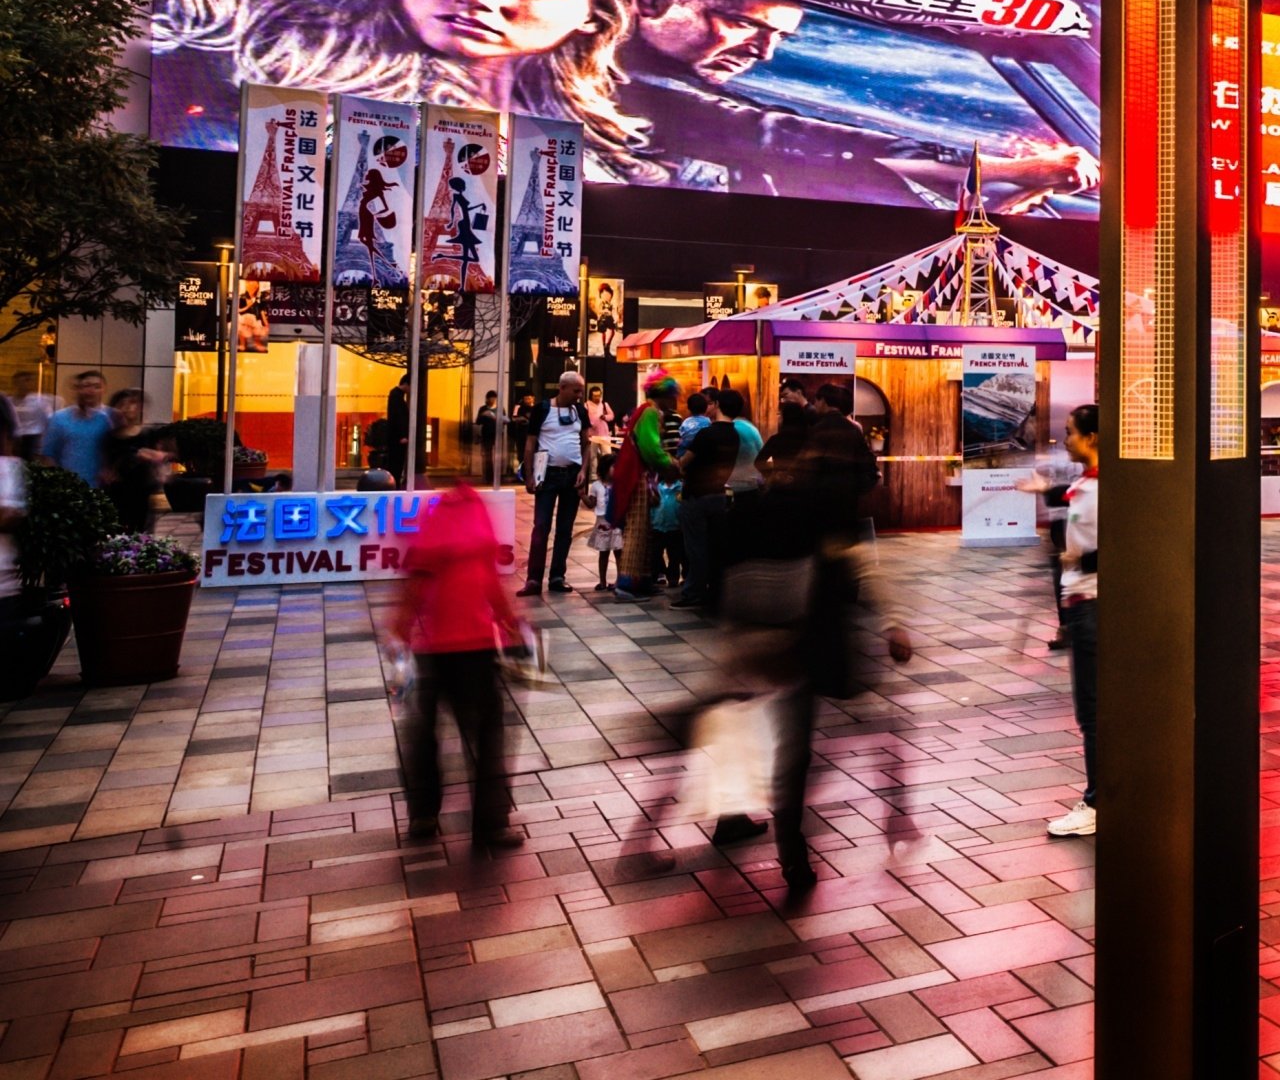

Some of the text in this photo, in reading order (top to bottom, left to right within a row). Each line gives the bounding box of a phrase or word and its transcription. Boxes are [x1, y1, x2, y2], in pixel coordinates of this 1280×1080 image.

[295, 110, 319, 239] 法国文化节
[278, 175, 294, 238] FESTIVAL
[556, 140, 576, 258] 法国文化节
[541, 198, 556, 257] FESTIVAL
[786, 357, 848, 368] FRENCH FESTIVAL
[875, 343, 963, 358] FESTIVAL FRAN
[969, 357, 1029, 368] FRENCH FESTIVAL
[220, 496, 438, 544] 法国文化
[204, 549, 353, 578] FESTIVAL
